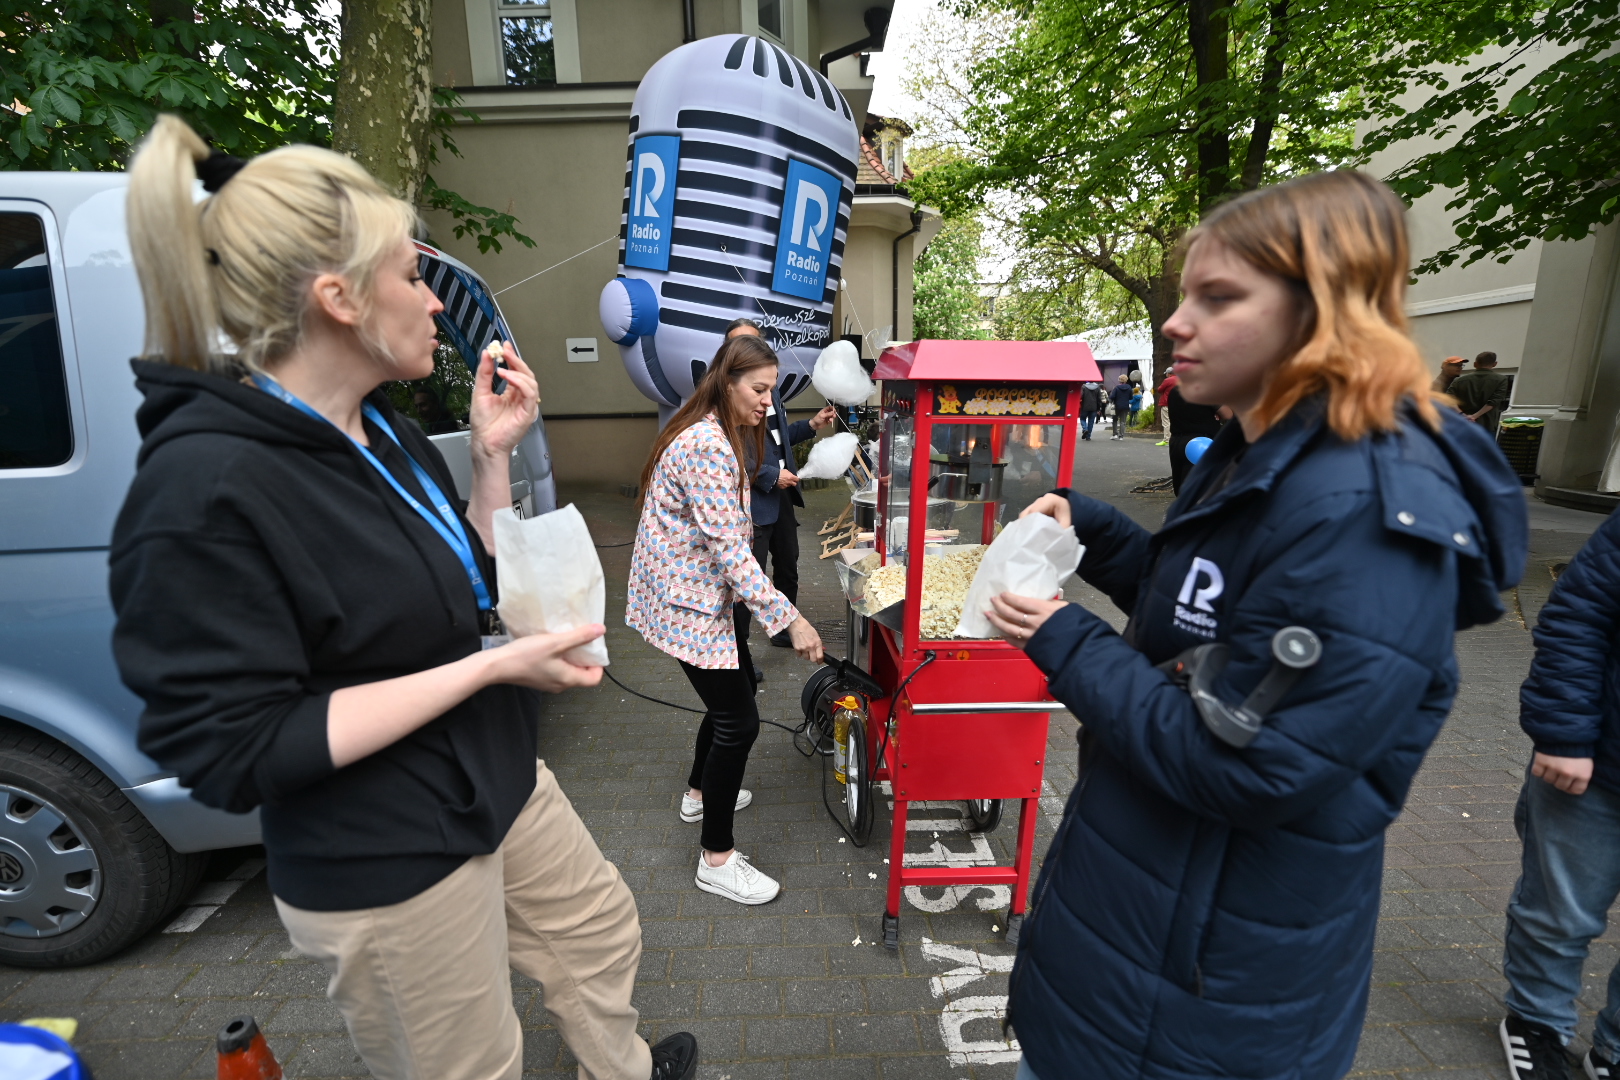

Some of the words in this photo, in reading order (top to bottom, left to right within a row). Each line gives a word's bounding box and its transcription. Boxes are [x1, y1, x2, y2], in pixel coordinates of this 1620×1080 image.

[633, 152, 666, 218] R
[789, 178, 829, 252] R
[631, 223, 661, 241] Radio
[630, 241, 659, 255] Poznań
[786, 250, 821, 273] Radio
[784, 269, 818, 287] Poznań
